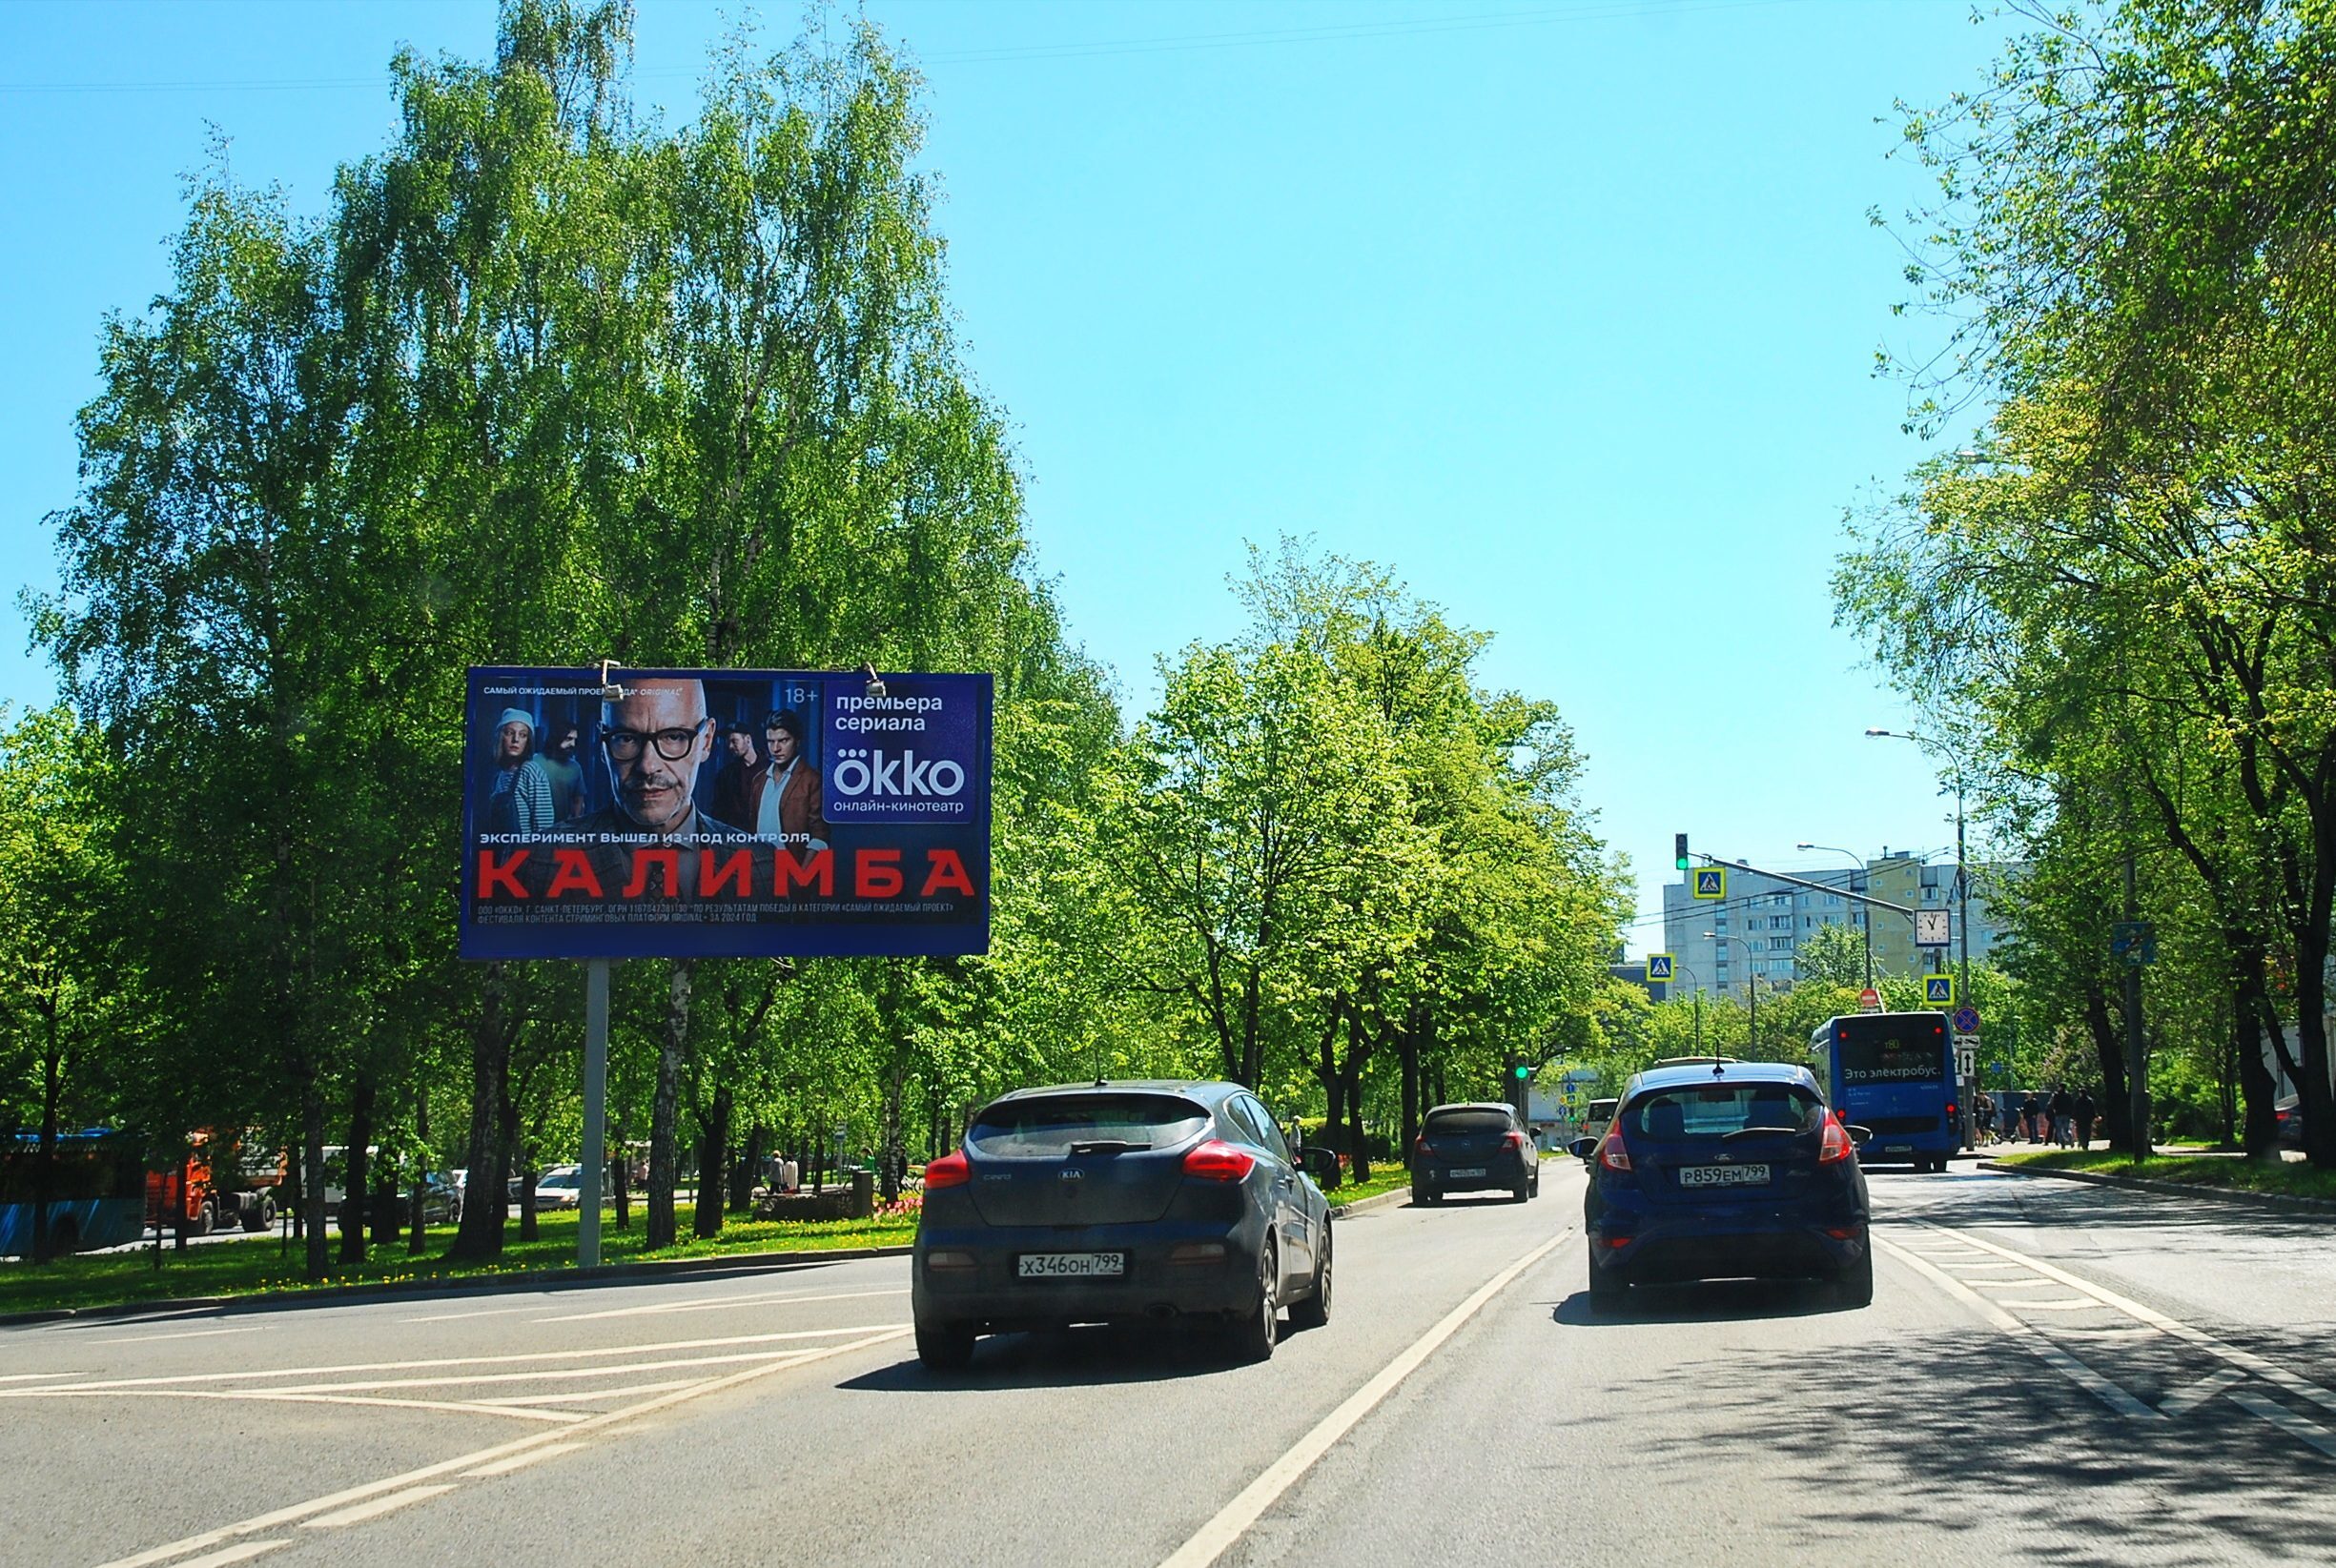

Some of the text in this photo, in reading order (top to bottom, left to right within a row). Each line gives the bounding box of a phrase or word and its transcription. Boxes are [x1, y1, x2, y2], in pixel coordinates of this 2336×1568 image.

[483, 685, 518, 696] САМЫЙ
[519, 685, 577, 696] ОЖИДАЕМЫЙ
[785, 688, 819, 704] 18+
[835, 696, 943, 714] премьера
[834, 717, 926, 733] сериала
[833, 801, 964, 814] онлайн-кинотеатр
[480, 832, 810, 845] ЭКСПЕРИМЕНТ ВЫШЕЛ ИЗ-ПОД КОНТРОЛЯ
[478, 848, 975, 899] КАЛИМБА
[525, 915, 564, 924] КОНТЕНТА
[627, 913, 670, 923] ПЛАТФОРМ
[721, 913, 740, 923] 2024
[741, 913, 757, 924] ГОД
[1845, 1065, 1941, 1080] Это электробус.
[1061, 1171, 1081, 1179] KIA
[1684, 1168, 1742, 1183] Р859ЕМ
[1744, 1166, 1766, 1176] 799
[1024, 1254, 1119, 1274] Х346ОН 799
